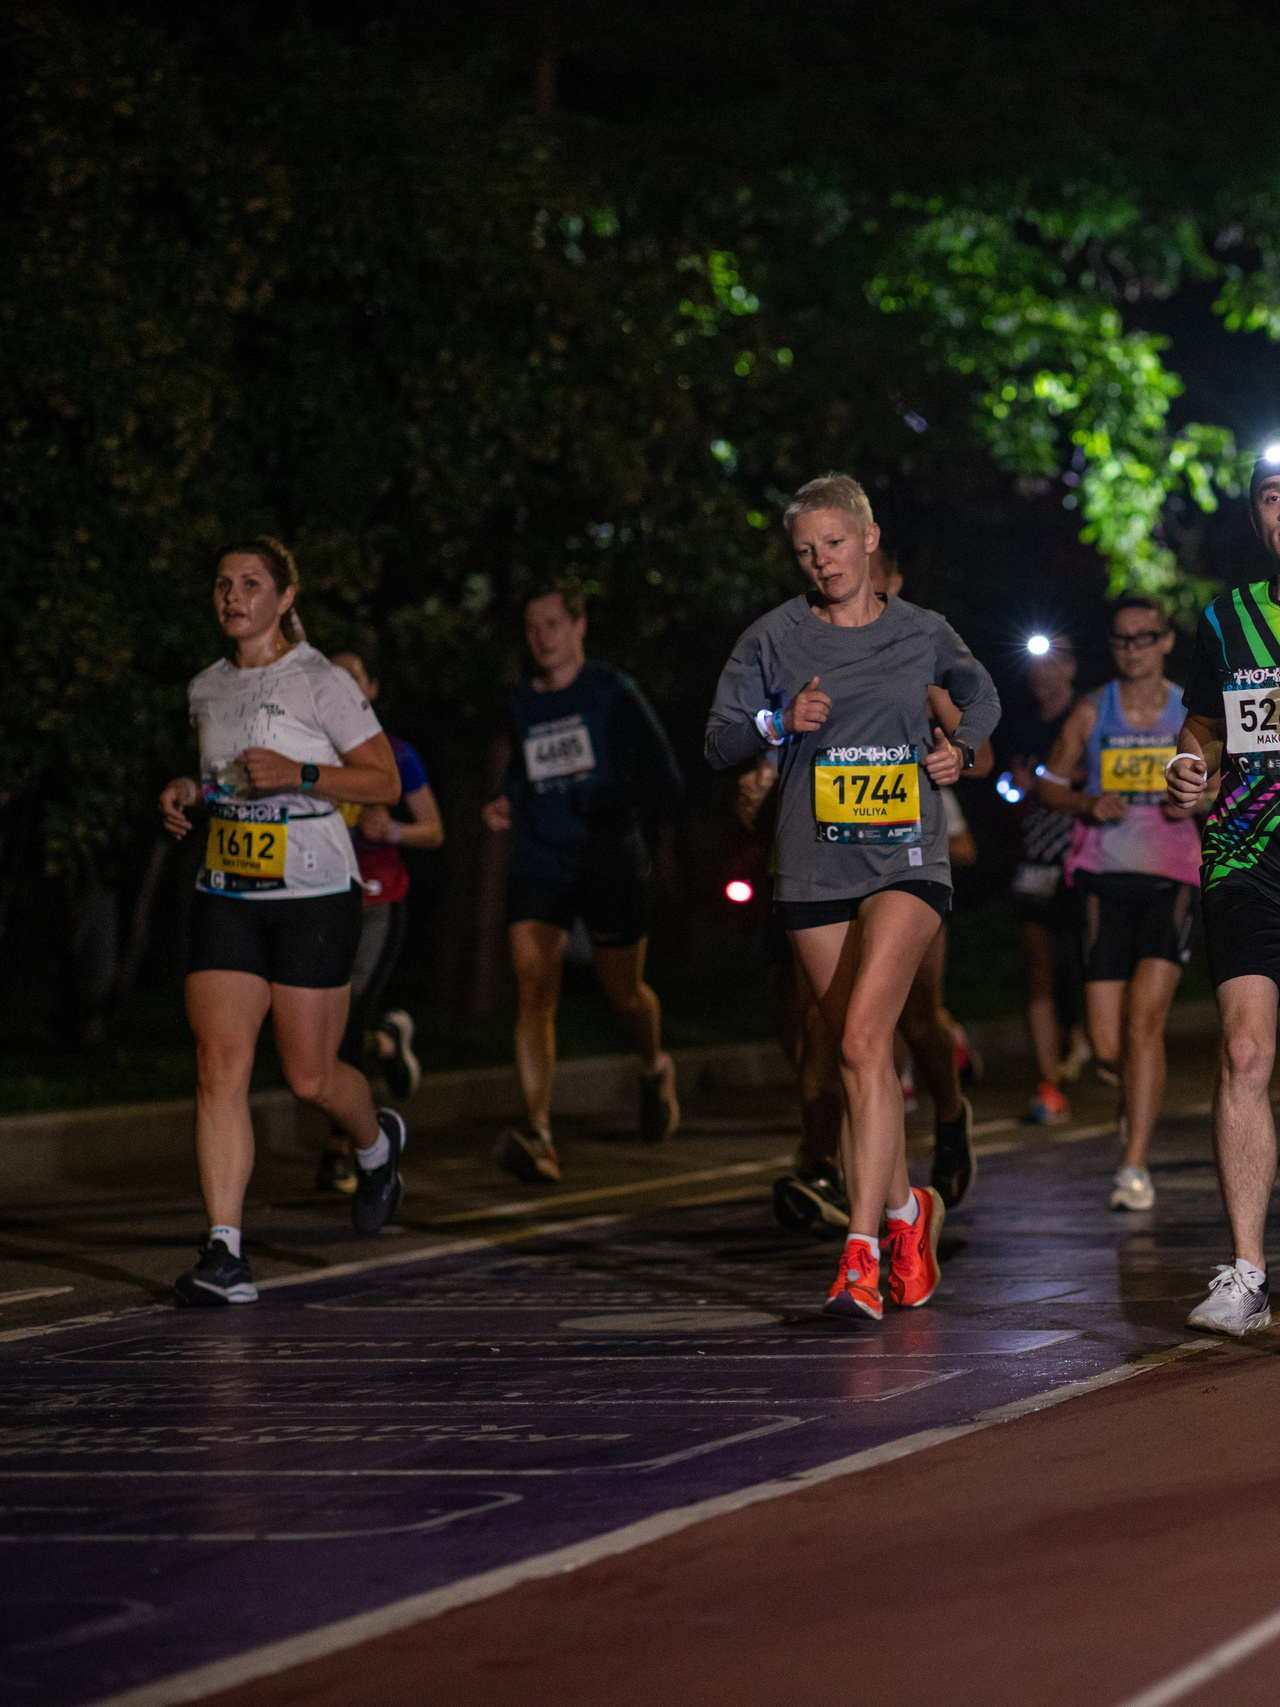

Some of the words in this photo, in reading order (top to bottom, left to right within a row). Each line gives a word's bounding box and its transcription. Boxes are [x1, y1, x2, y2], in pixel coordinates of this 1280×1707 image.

[833, 773, 907, 804] 1744
[853, 808, 887, 816] YULIYA
[217, 828, 275, 858] 1612
